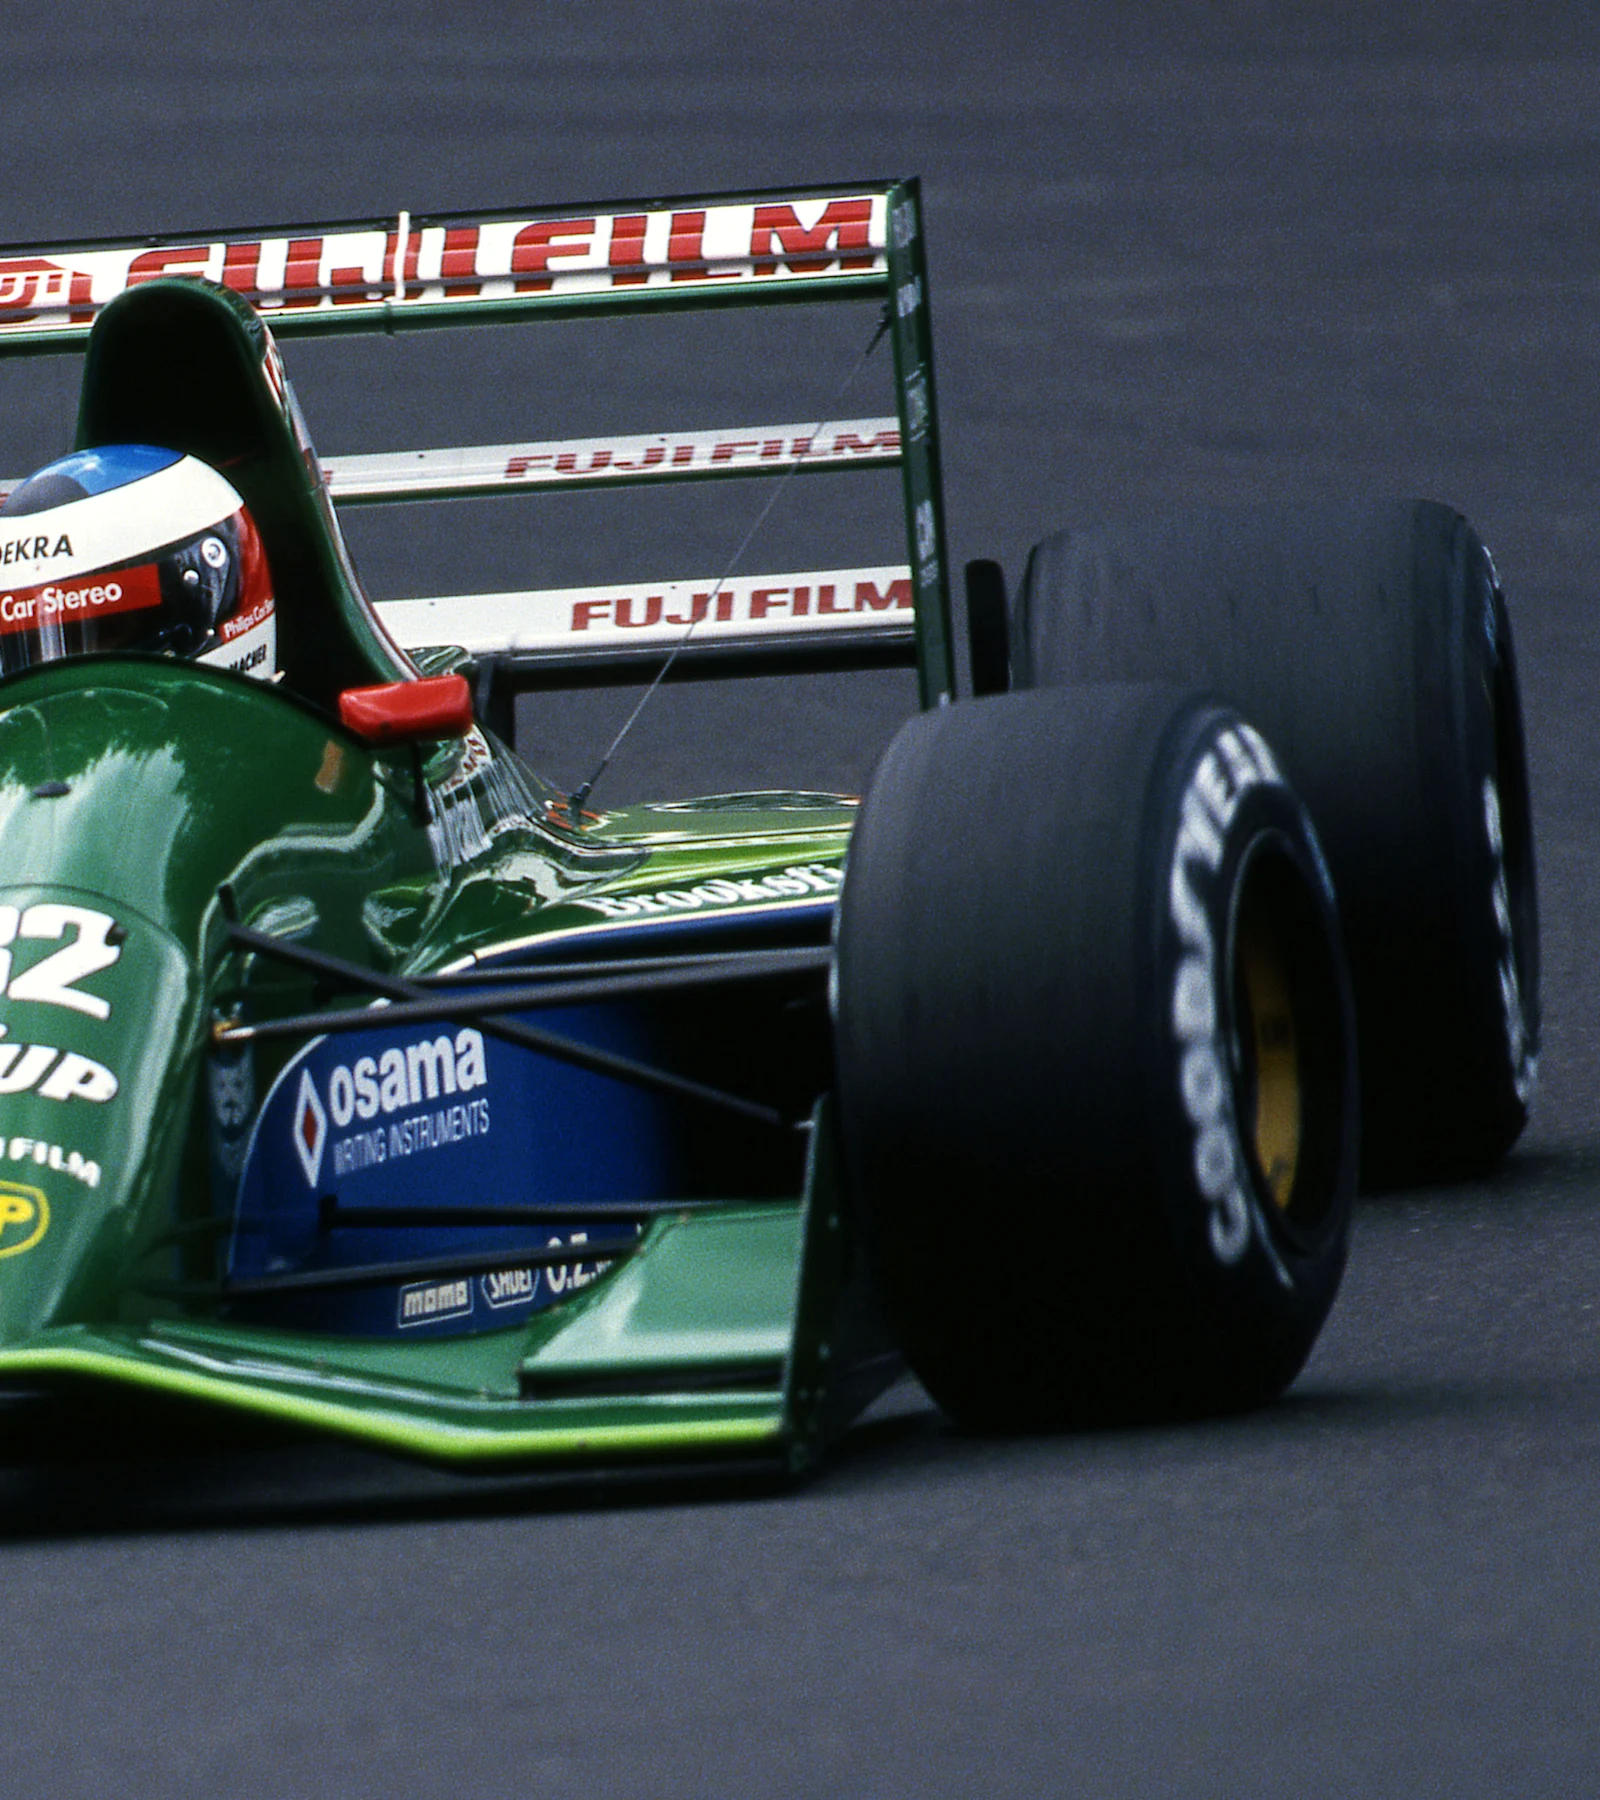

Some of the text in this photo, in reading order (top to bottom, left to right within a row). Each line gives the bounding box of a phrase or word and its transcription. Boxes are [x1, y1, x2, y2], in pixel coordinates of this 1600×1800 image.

[1, 594, 37, 622] Car
[42, 582, 122, 614] Stereo
[329, 1027, 488, 1127] osama
[389, 1098, 490, 1157] INSTRUMENTS
